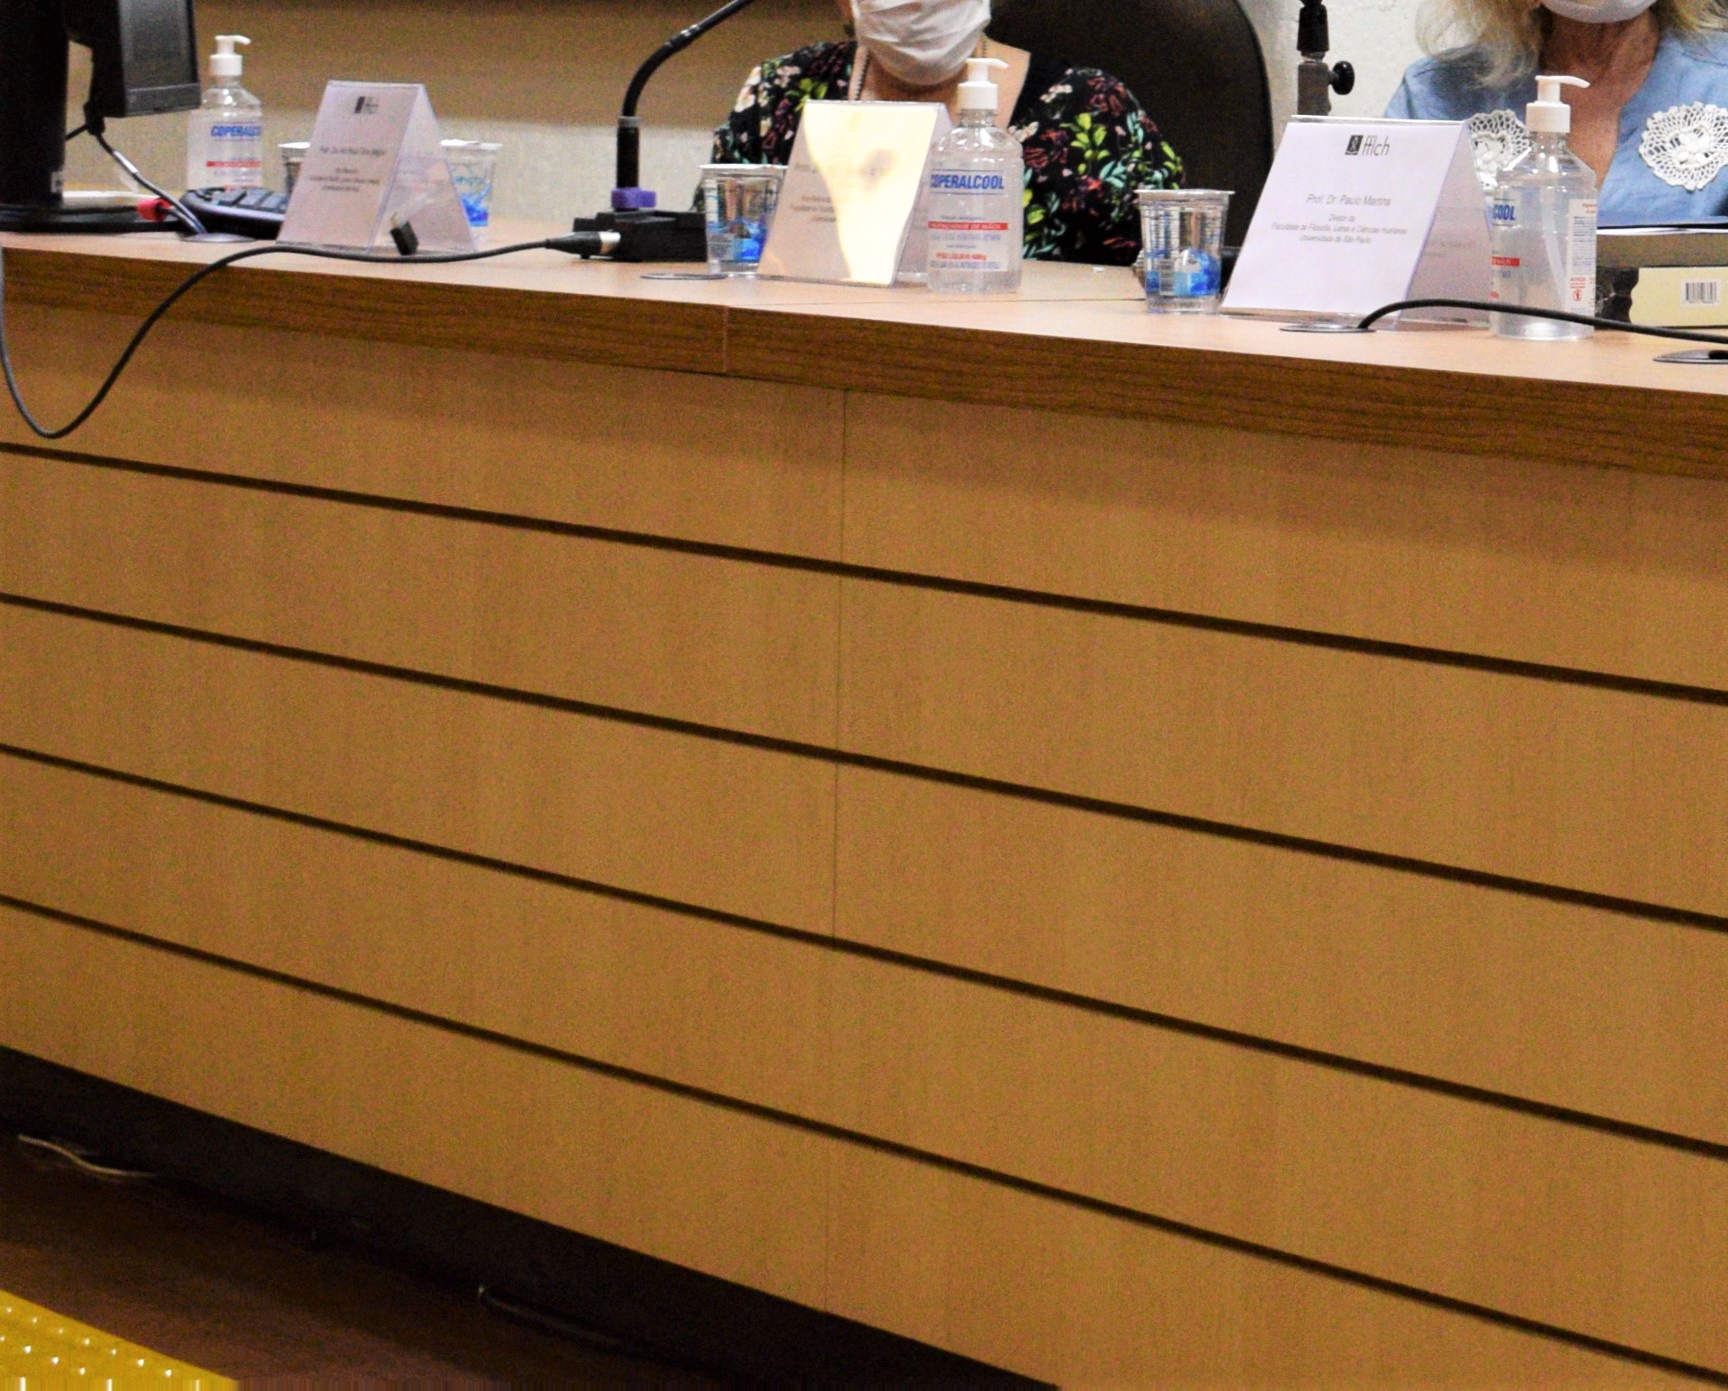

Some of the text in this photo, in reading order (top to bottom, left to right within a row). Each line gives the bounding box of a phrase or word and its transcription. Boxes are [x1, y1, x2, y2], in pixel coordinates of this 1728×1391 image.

[1361, 134, 1391, 157] fflch
[1340, 194, 1361, 206] Paulo
[1363, 195, 1391, 207] Martins
